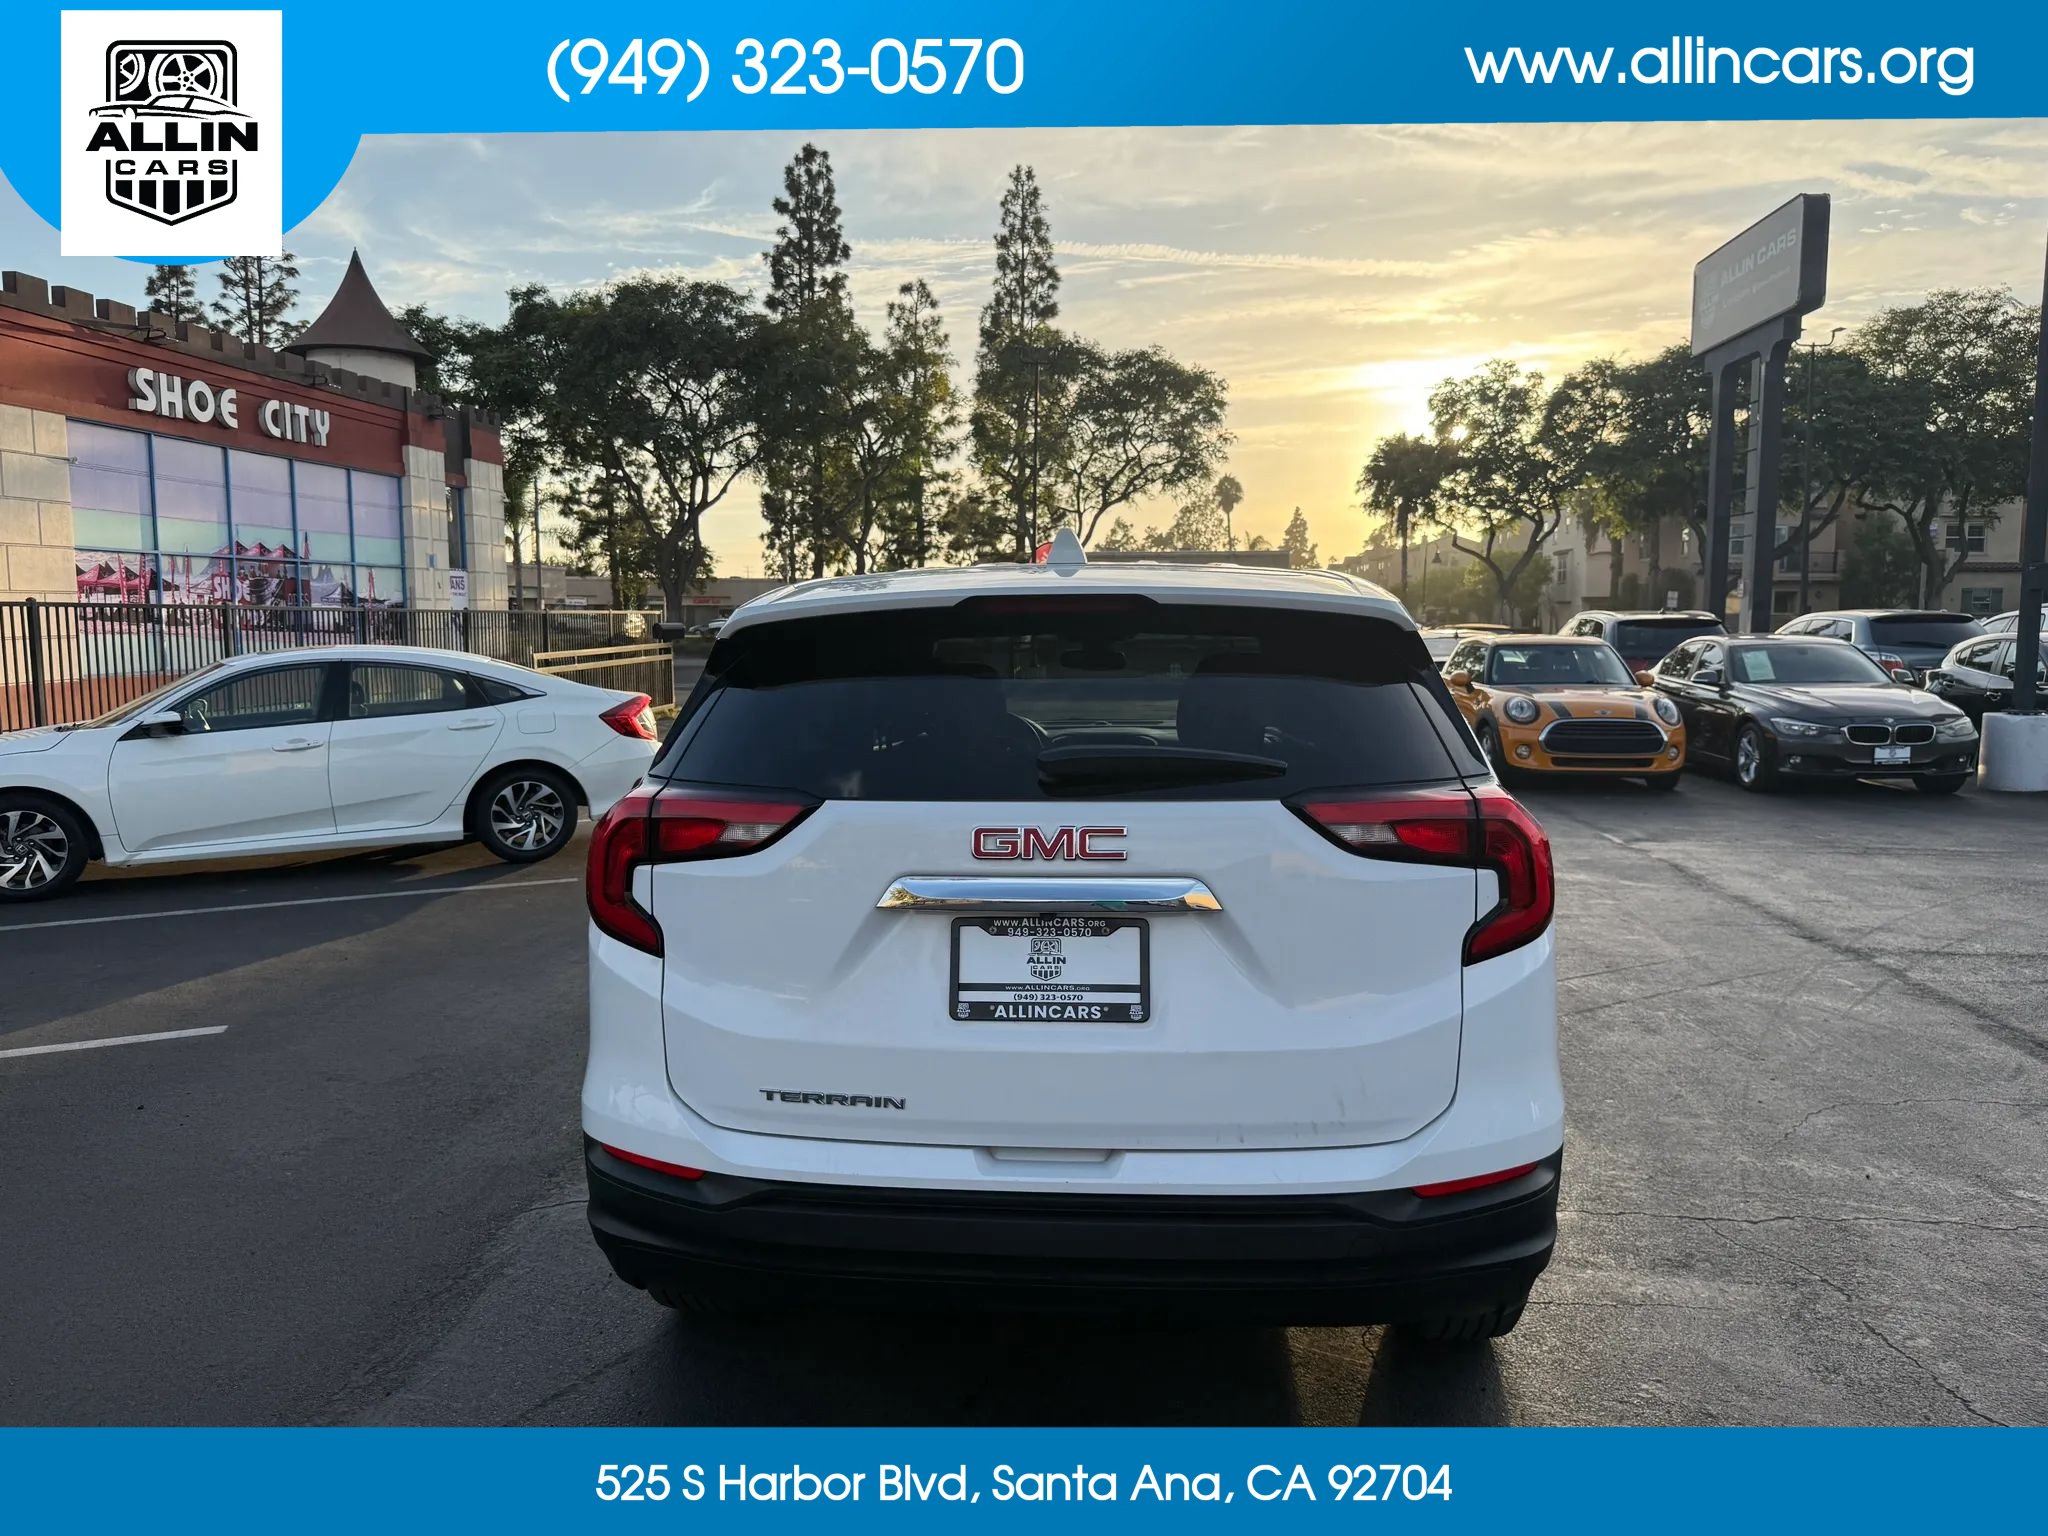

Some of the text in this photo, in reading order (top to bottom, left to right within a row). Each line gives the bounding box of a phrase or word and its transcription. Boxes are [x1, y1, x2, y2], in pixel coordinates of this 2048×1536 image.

[1757, 228, 1797, 265] CARS
[129, 367, 330, 447] SHOE CITY
[450, 575, 466, 591] ANS
[972, 826, 1128, 860] GMC
[1007, 927, 1092, 937] 949-323-0570
[1026, 956, 1066, 965] ALLIN
[1013, 993, 1083, 1002] (949) 323-0570
[994, 1005, 1102, 1019] ALLINCARS
[759, 1089, 906, 1110] TERRAIN
